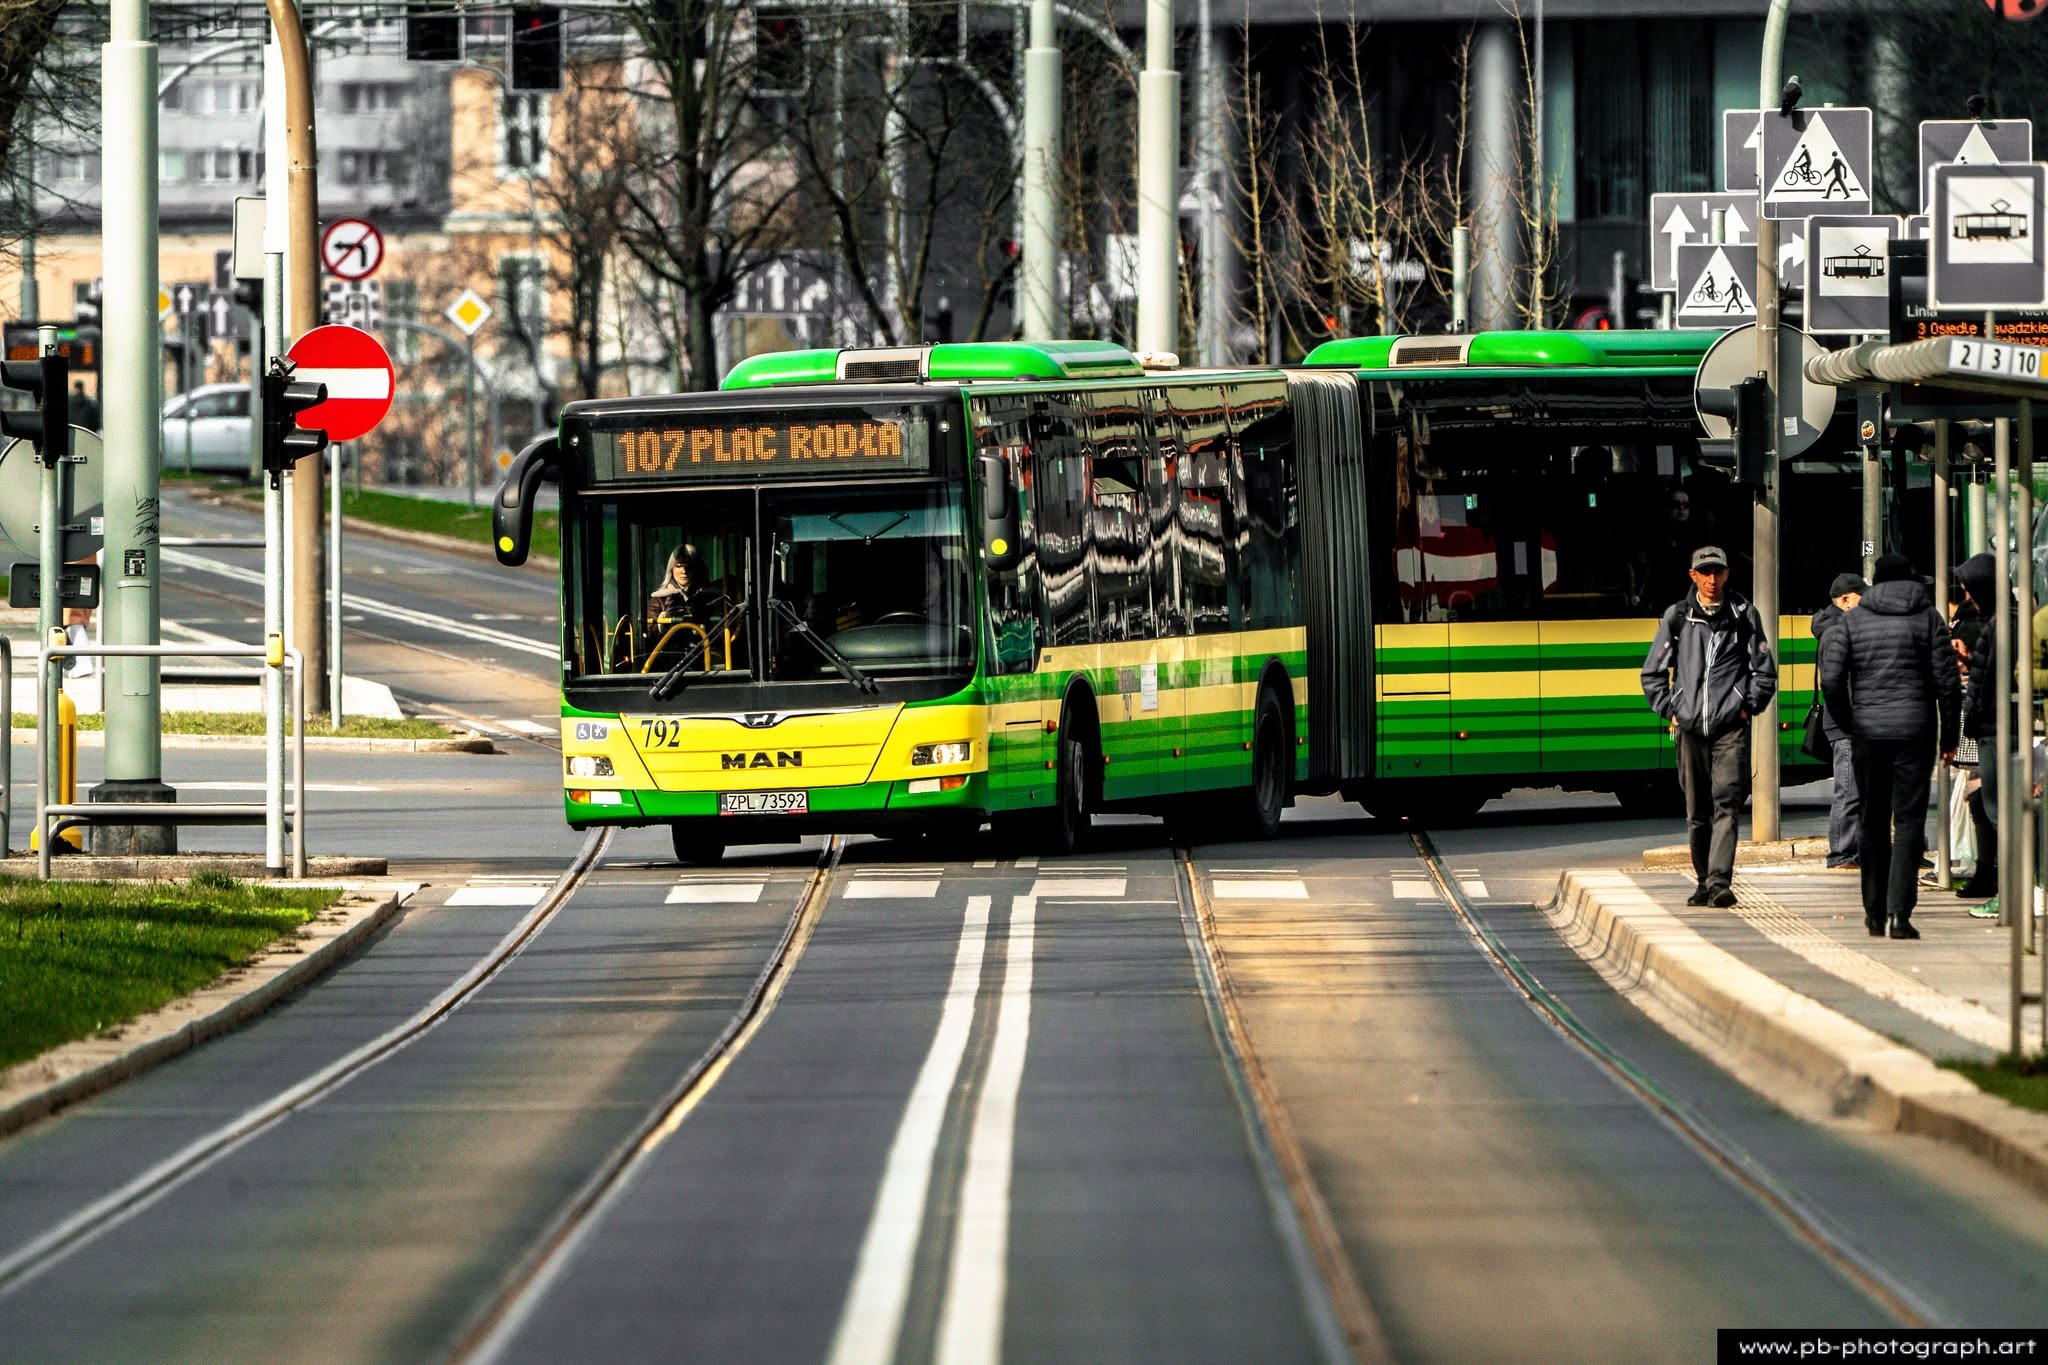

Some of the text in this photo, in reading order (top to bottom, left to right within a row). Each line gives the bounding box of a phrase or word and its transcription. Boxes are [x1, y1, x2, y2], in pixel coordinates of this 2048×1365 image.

[1918, 321, 2048, 335] 3 Osiedle awadzkie
[1961, 345, 2036, 373] 2 3 10
[619, 422, 900, 472] 107 PLAC RODŁA
[641, 720, 680, 747] 792
[721, 751, 802, 769] MAN
[728, 793, 805, 810] ZPL 73592
